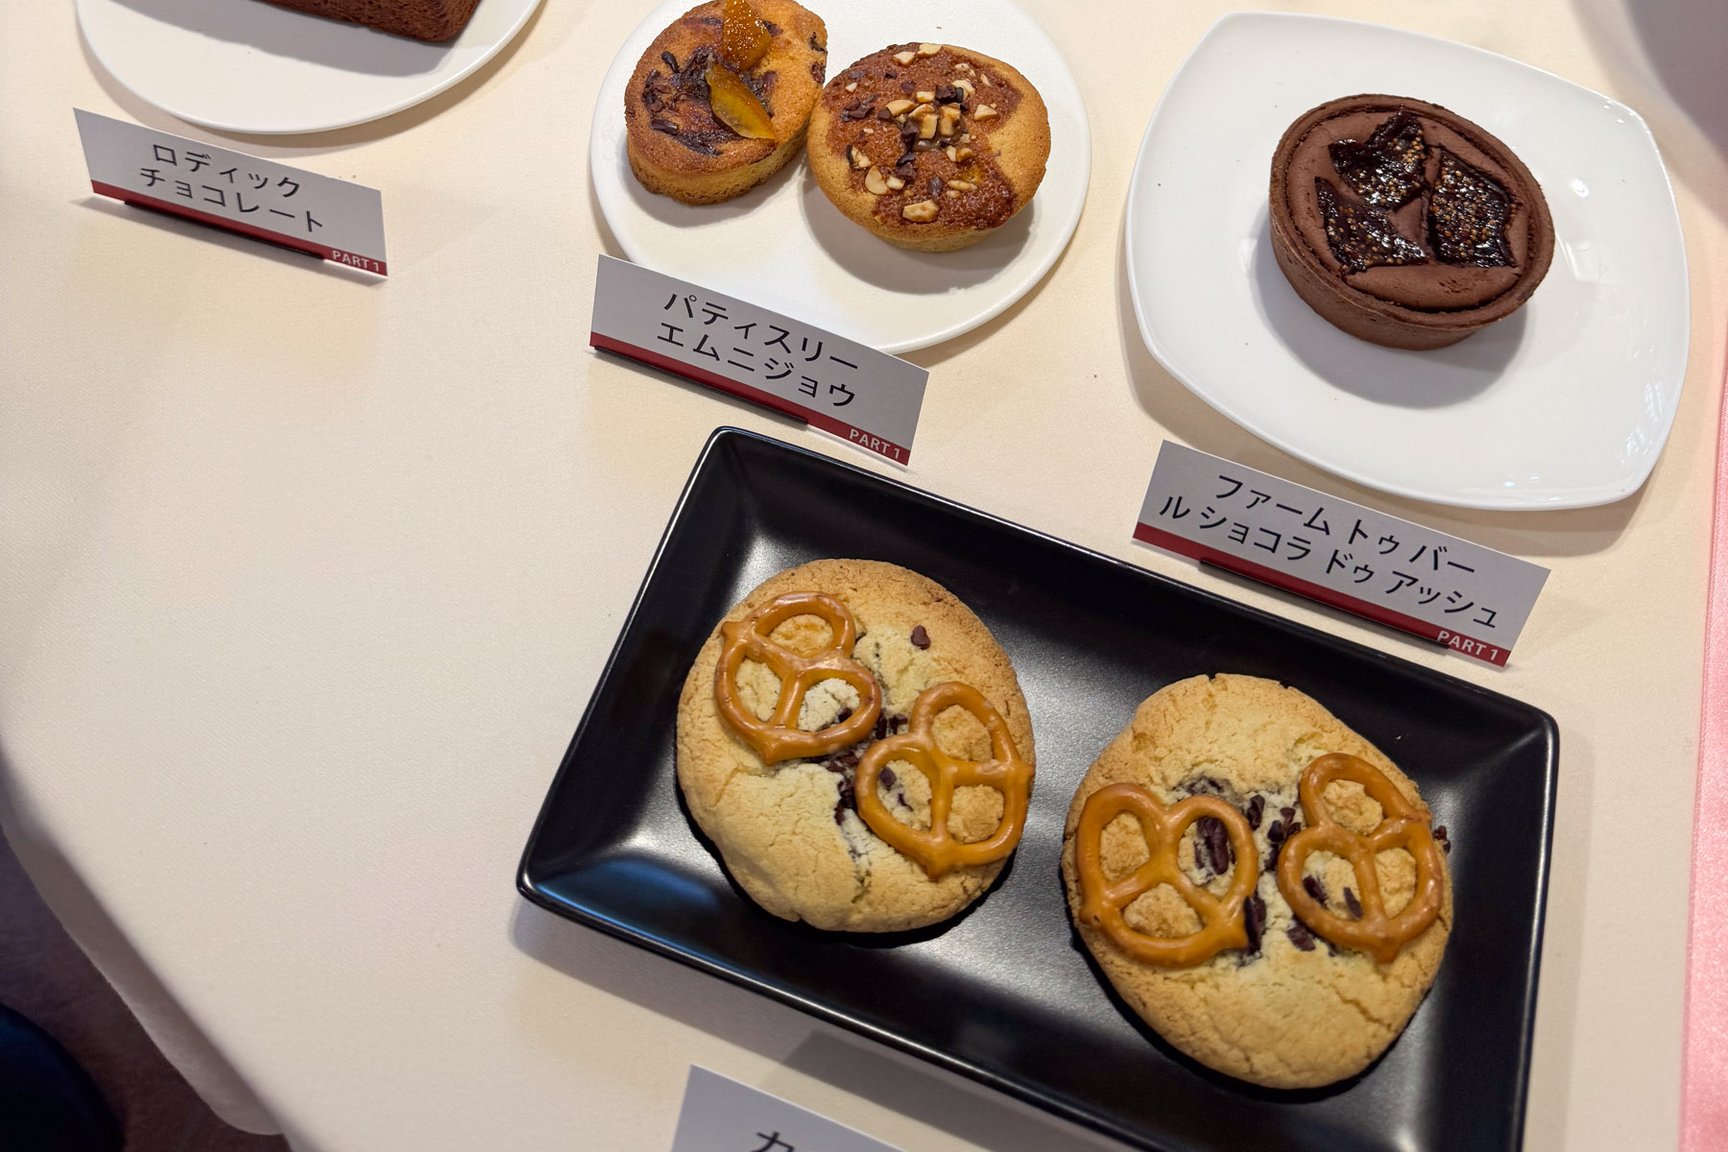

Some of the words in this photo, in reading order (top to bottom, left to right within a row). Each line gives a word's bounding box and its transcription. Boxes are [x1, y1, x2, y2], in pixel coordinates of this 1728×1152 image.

[140, 167, 323, 232] チョコレート
[153, 144, 300, 198] ロディック
[332, 250, 370, 270] PART
[372, 261, 380, 272] 1
[664, 293, 858, 369] パティスリー
[657, 322, 856, 407] エムニジョウ
[850, 429, 892, 455] PART
[893, 447, 900, 459] 1
[1215, 474, 1331, 536] ファーム
[1348, 519, 1400, 556] トゥ
[1409, 545, 1475, 574] バー
[1159, 496, 1191, 520] ル
[1199, 506, 1312, 562] ショコラ
[1325, 553, 1374, 584] ドゥ
[1385, 570, 1497, 628] アッシュ
[1437, 630, 1488, 657] PART
[1490, 647, 1499, 660] 1
